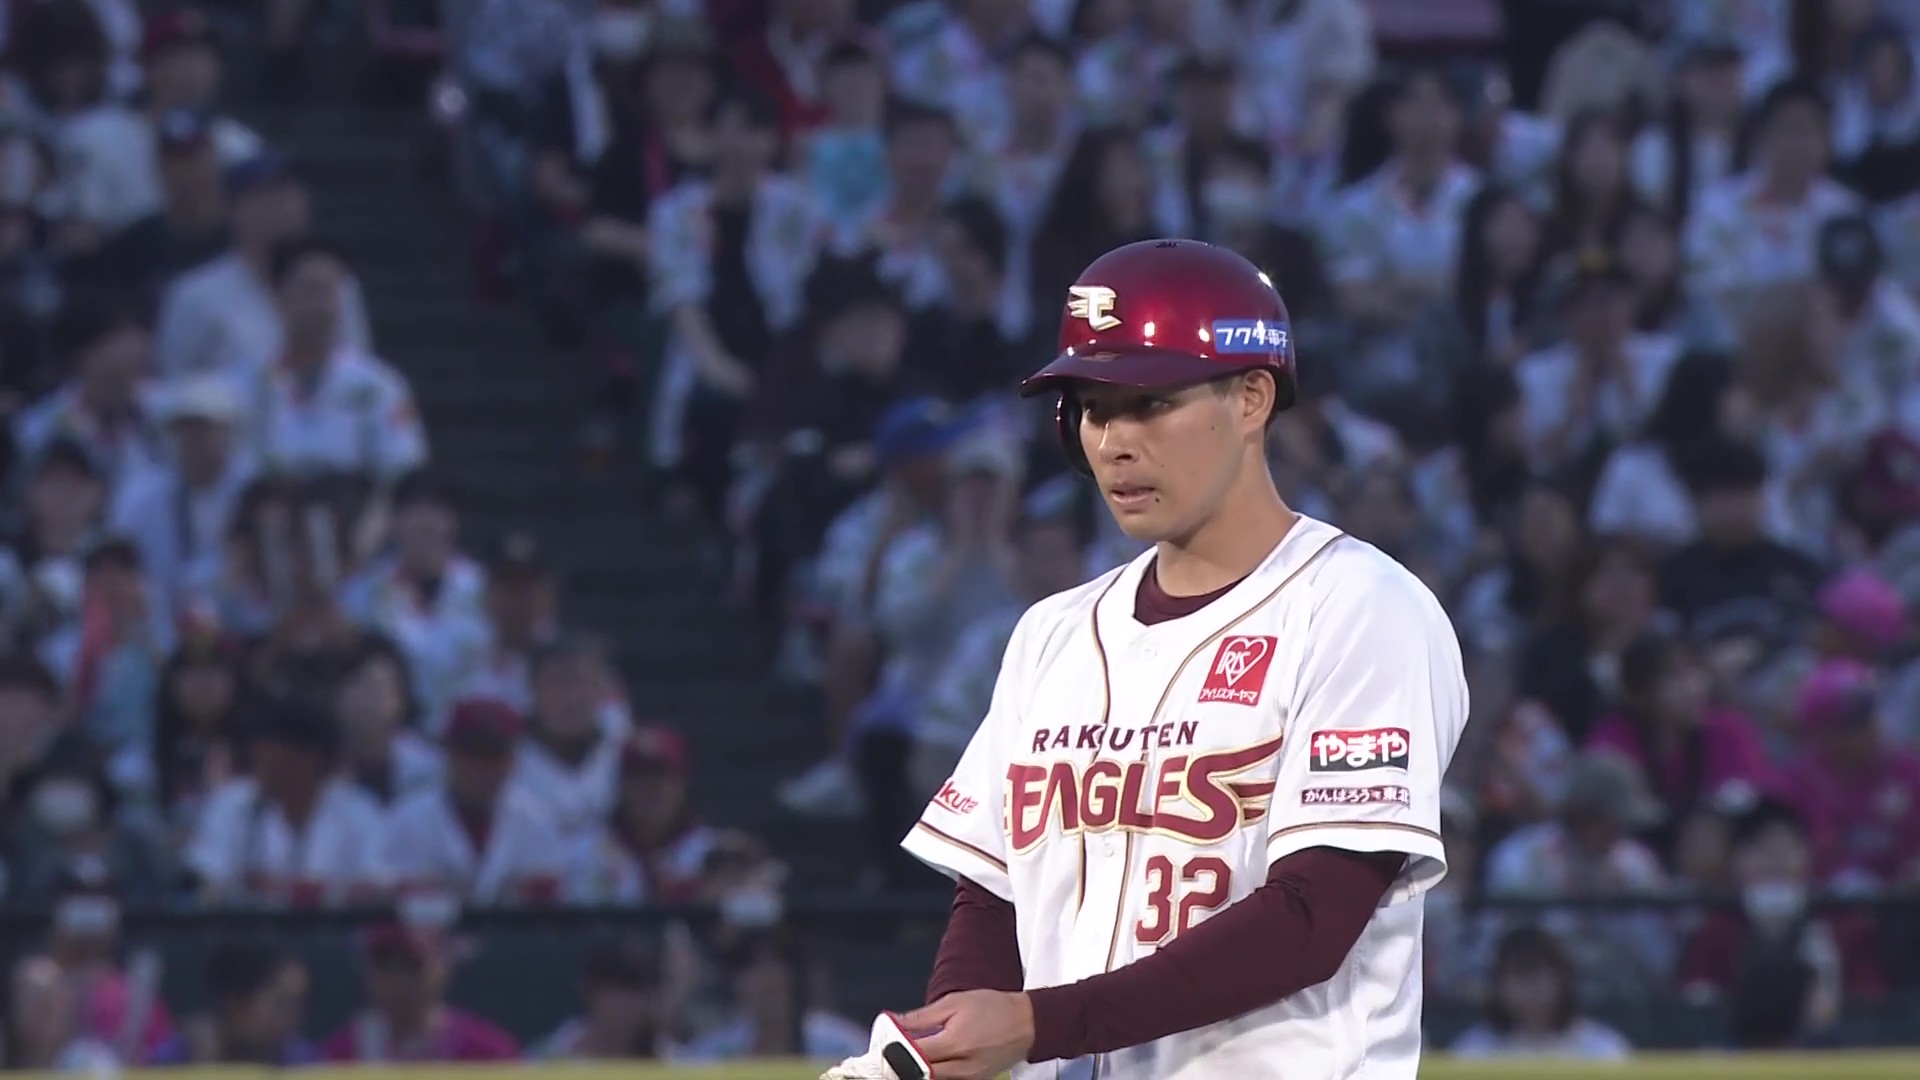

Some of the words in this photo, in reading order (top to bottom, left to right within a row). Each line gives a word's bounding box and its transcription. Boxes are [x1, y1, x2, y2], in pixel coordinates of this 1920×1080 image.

[1200, 687, 1258, 703] アイリスオーヤマ
[1032, 721, 1199, 753] RAKUTEN
[1313, 731, 1408, 768] やまや
[1003, 734, 1284, 854] EAGLES
[1135, 855, 1231, 944] 32
